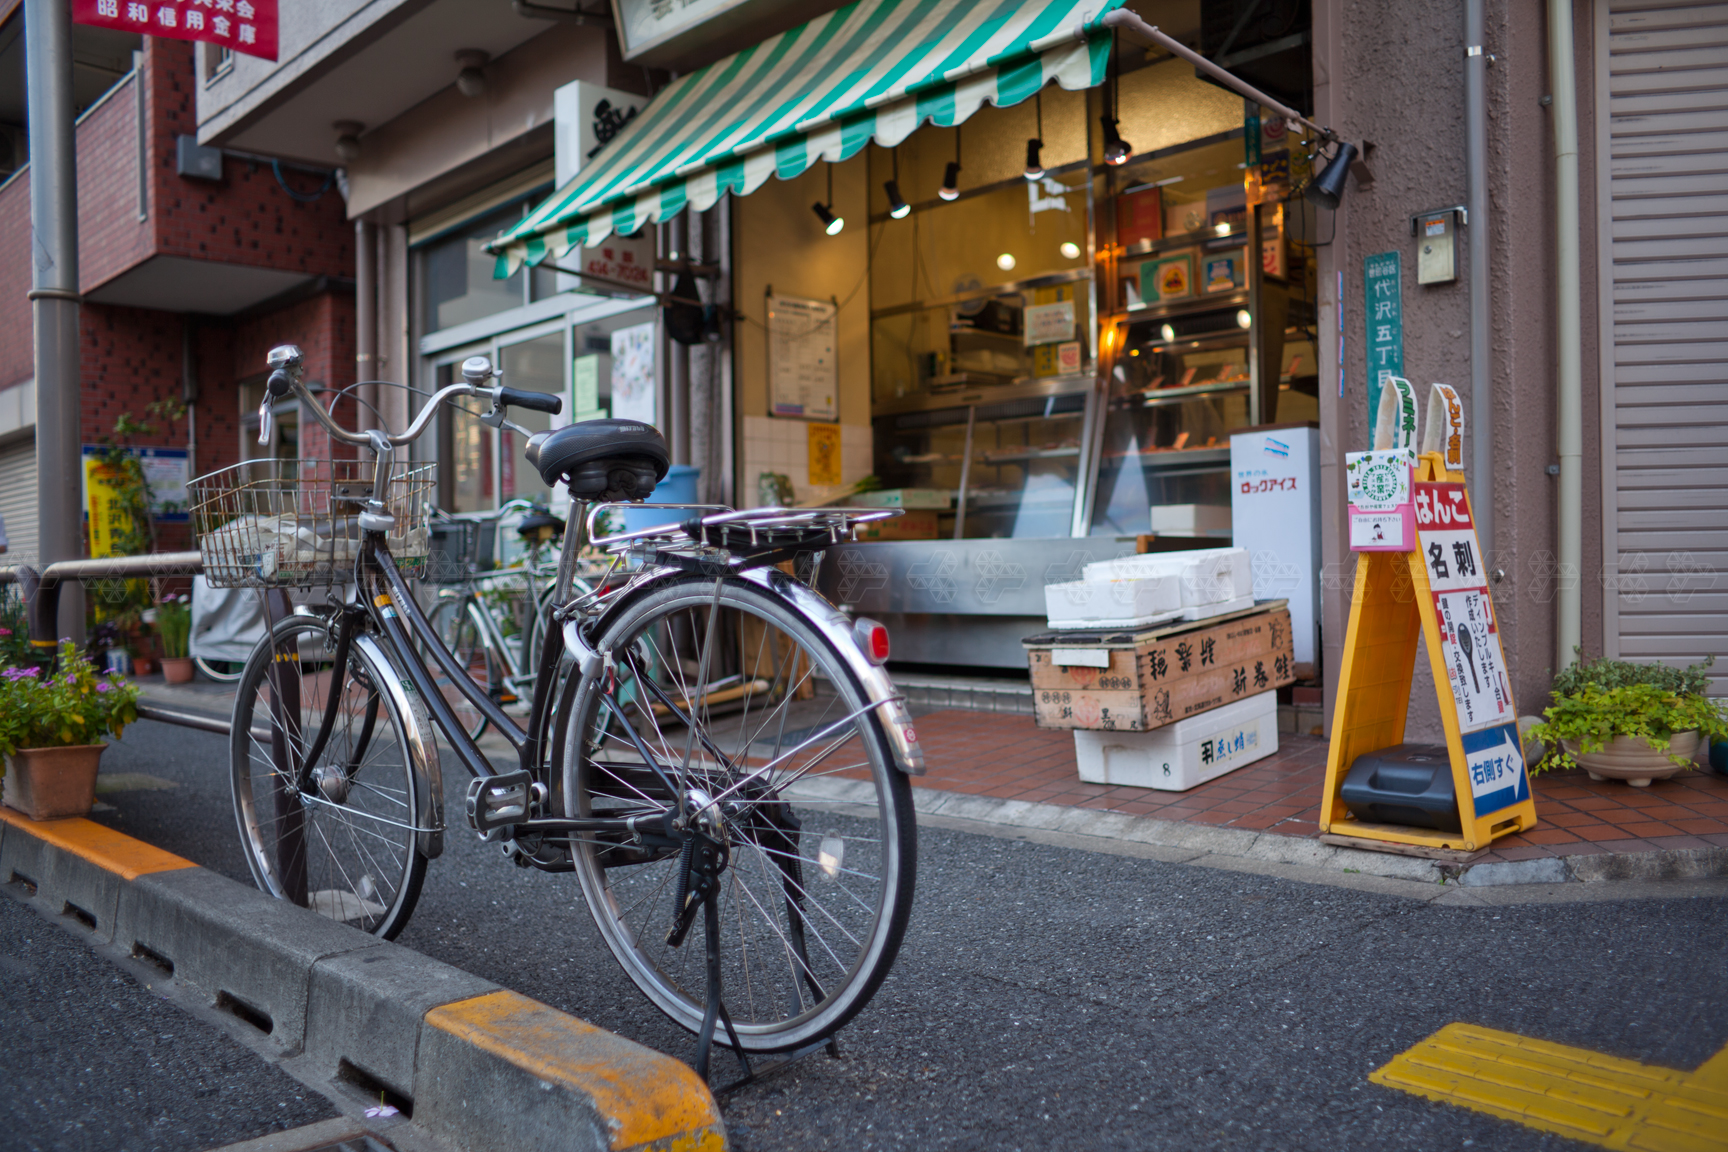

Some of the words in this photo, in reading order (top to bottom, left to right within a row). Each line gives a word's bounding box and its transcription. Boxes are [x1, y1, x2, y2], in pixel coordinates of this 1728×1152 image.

[98, 0, 256, 44] 昭和信用金庫
[1395, 379, 1415, 460] ラミネー
[1439, 386, 1462, 465] はんこ・名刺
[1241, 477, 1297, 494] ロックアイス
[1415, 489, 1470, 524] はんこ
[1428, 540, 1476, 580] 名刺
[1465, 595, 1491, 689] 作成いたします
[1232, 653, 1290, 695] 新巻鮭
[1162, 762, 1172, 777] 8
[1471, 753, 1515, 787] 右側すぐ
